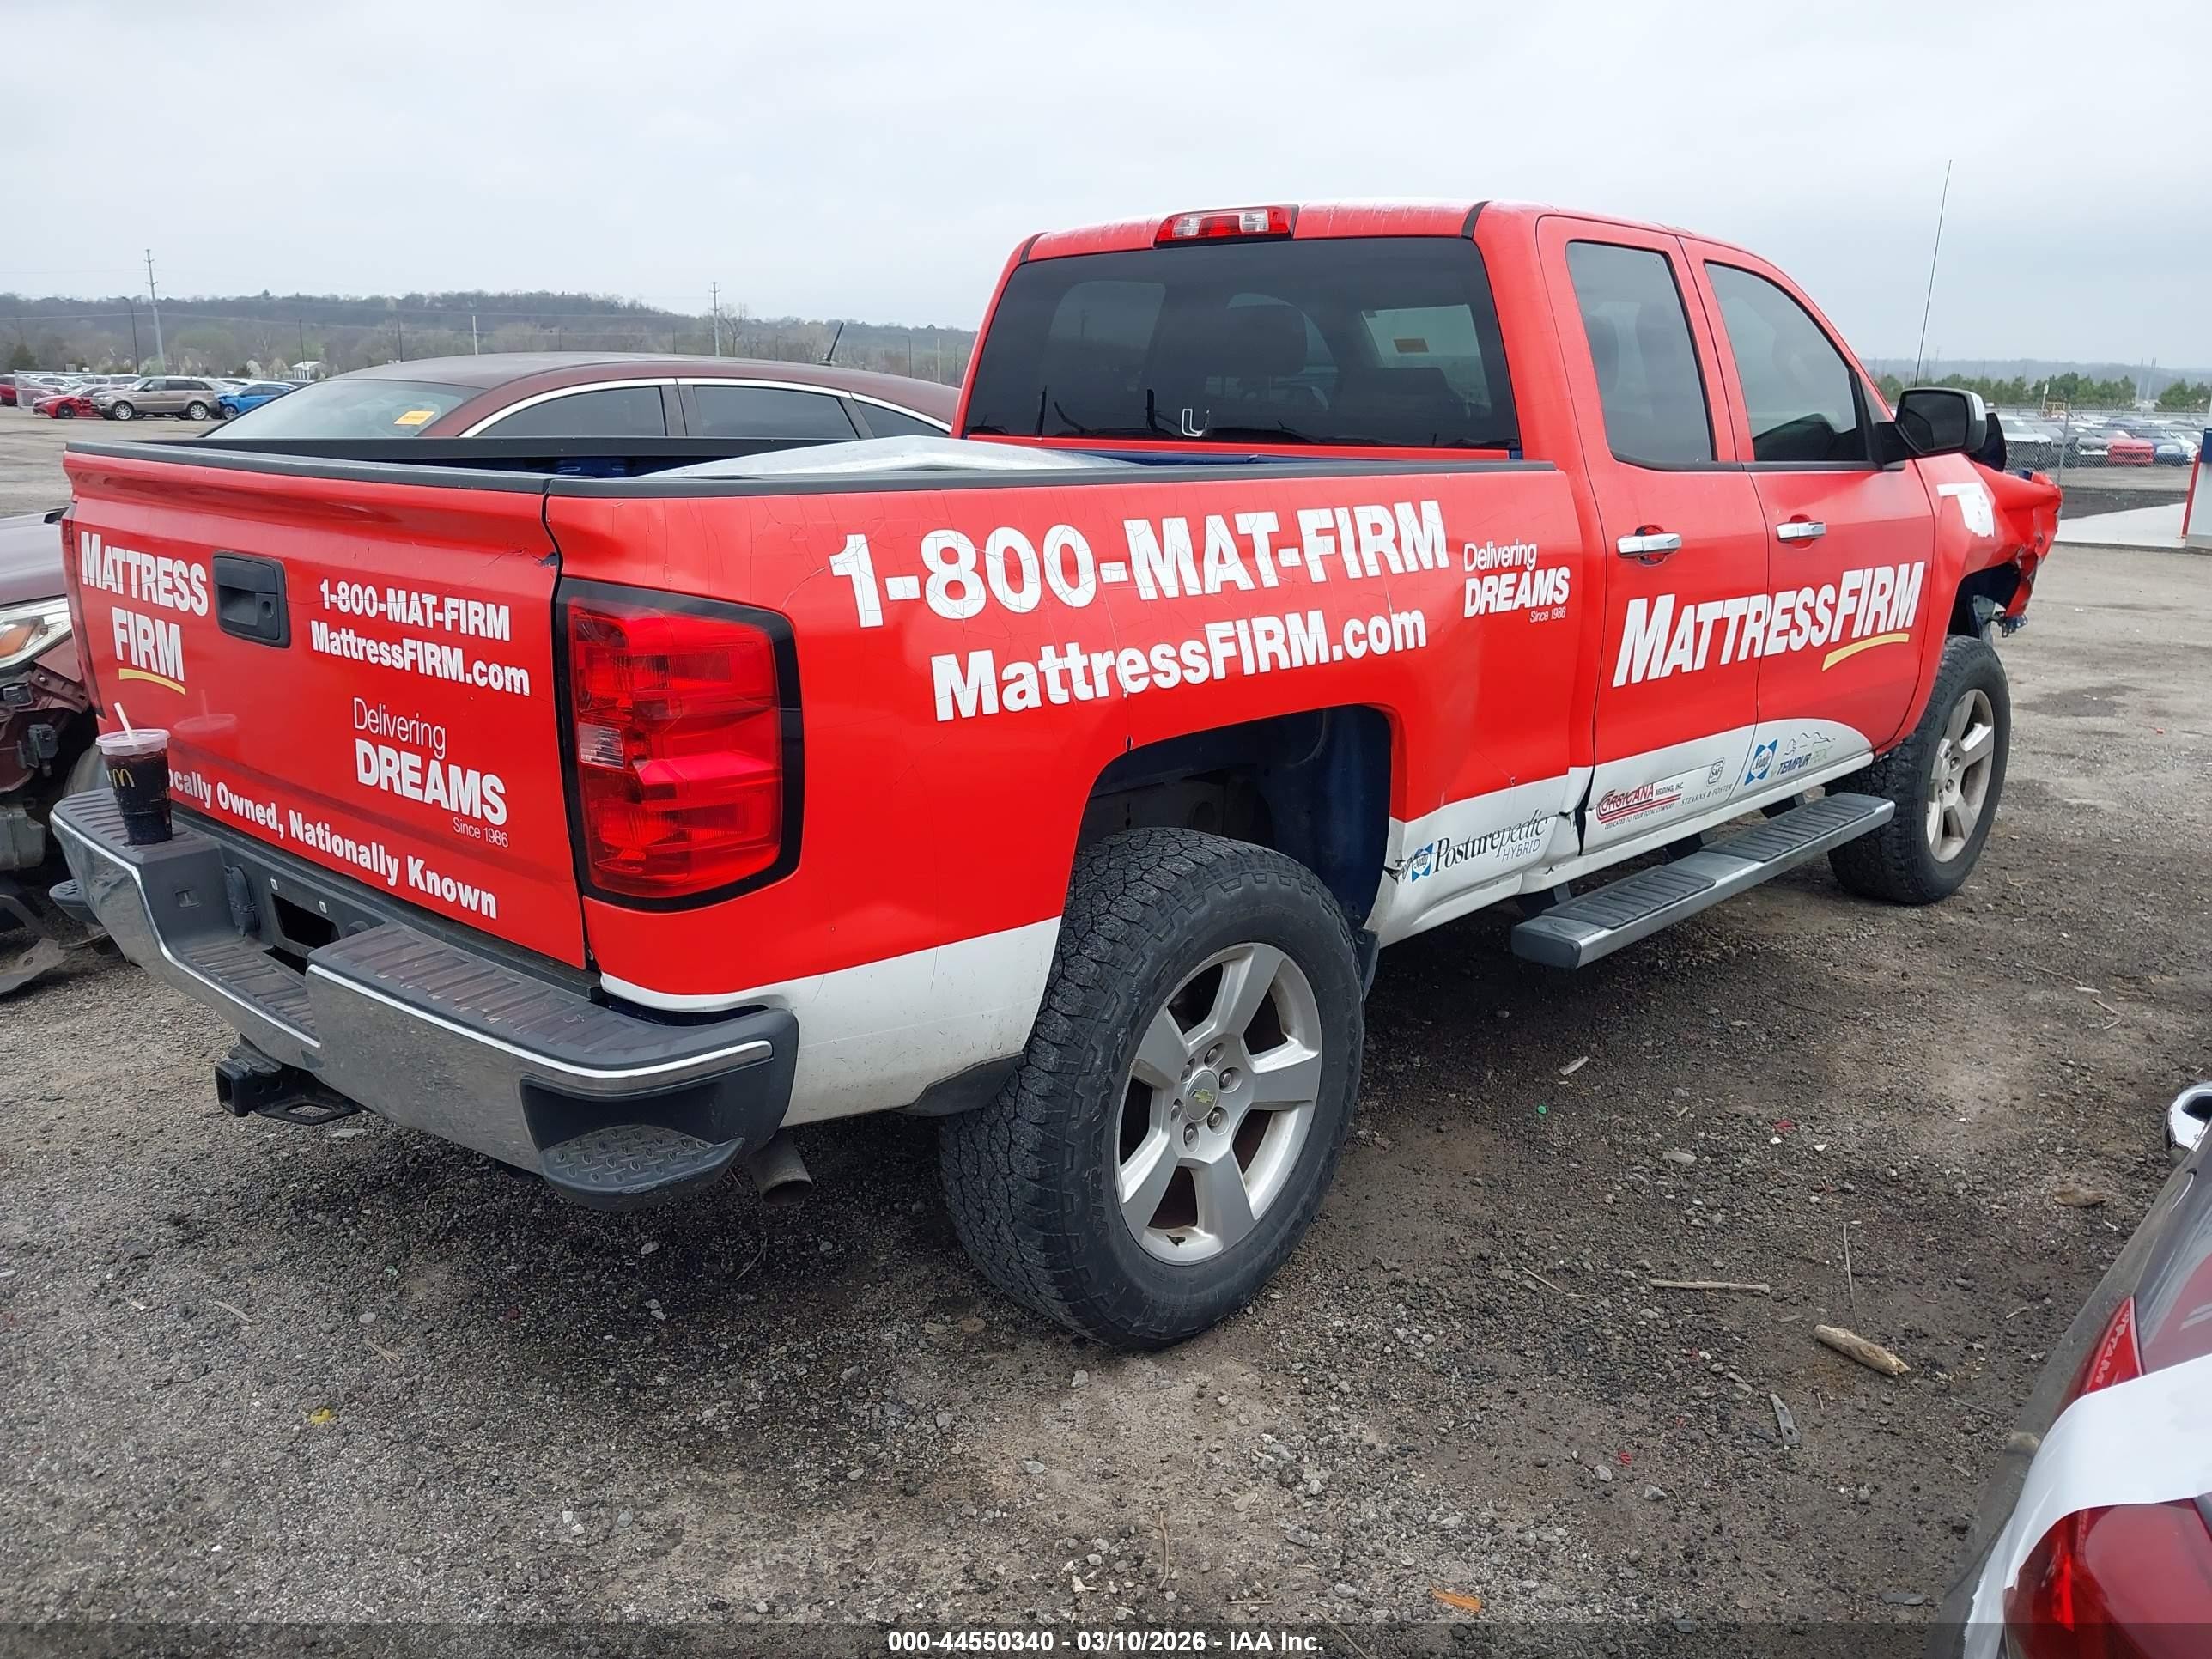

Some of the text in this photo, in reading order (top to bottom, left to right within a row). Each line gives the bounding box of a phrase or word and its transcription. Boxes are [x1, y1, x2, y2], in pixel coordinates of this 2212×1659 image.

[81, 532, 208, 616] MATTRESS
[830, 500, 1449, 629] 1-800-MAT-FIRM
[1463, 538, 1537, 572] Delivering
[319, 578, 510, 641] 1-800-MAT-FIRM
[1463, 566, 1571, 618] DREAMS
[1530, 606, 1566, 623] Since 1986
[111, 607, 185, 682] FIRM
[310, 620, 530, 696] MattressFIRM.com
[930, 605, 1427, 722] MattressFIRM.com
[353, 696, 447, 759] Delivering
[355, 738, 508, 826] DREAMS
[169, 769, 498, 919] ocally Owned, Nationally Known
[453, 817, 509, 848] Since 1986
[1432, 808, 1548, 874] Posturepedic
[1503, 838, 1541, 861] HYBRID
